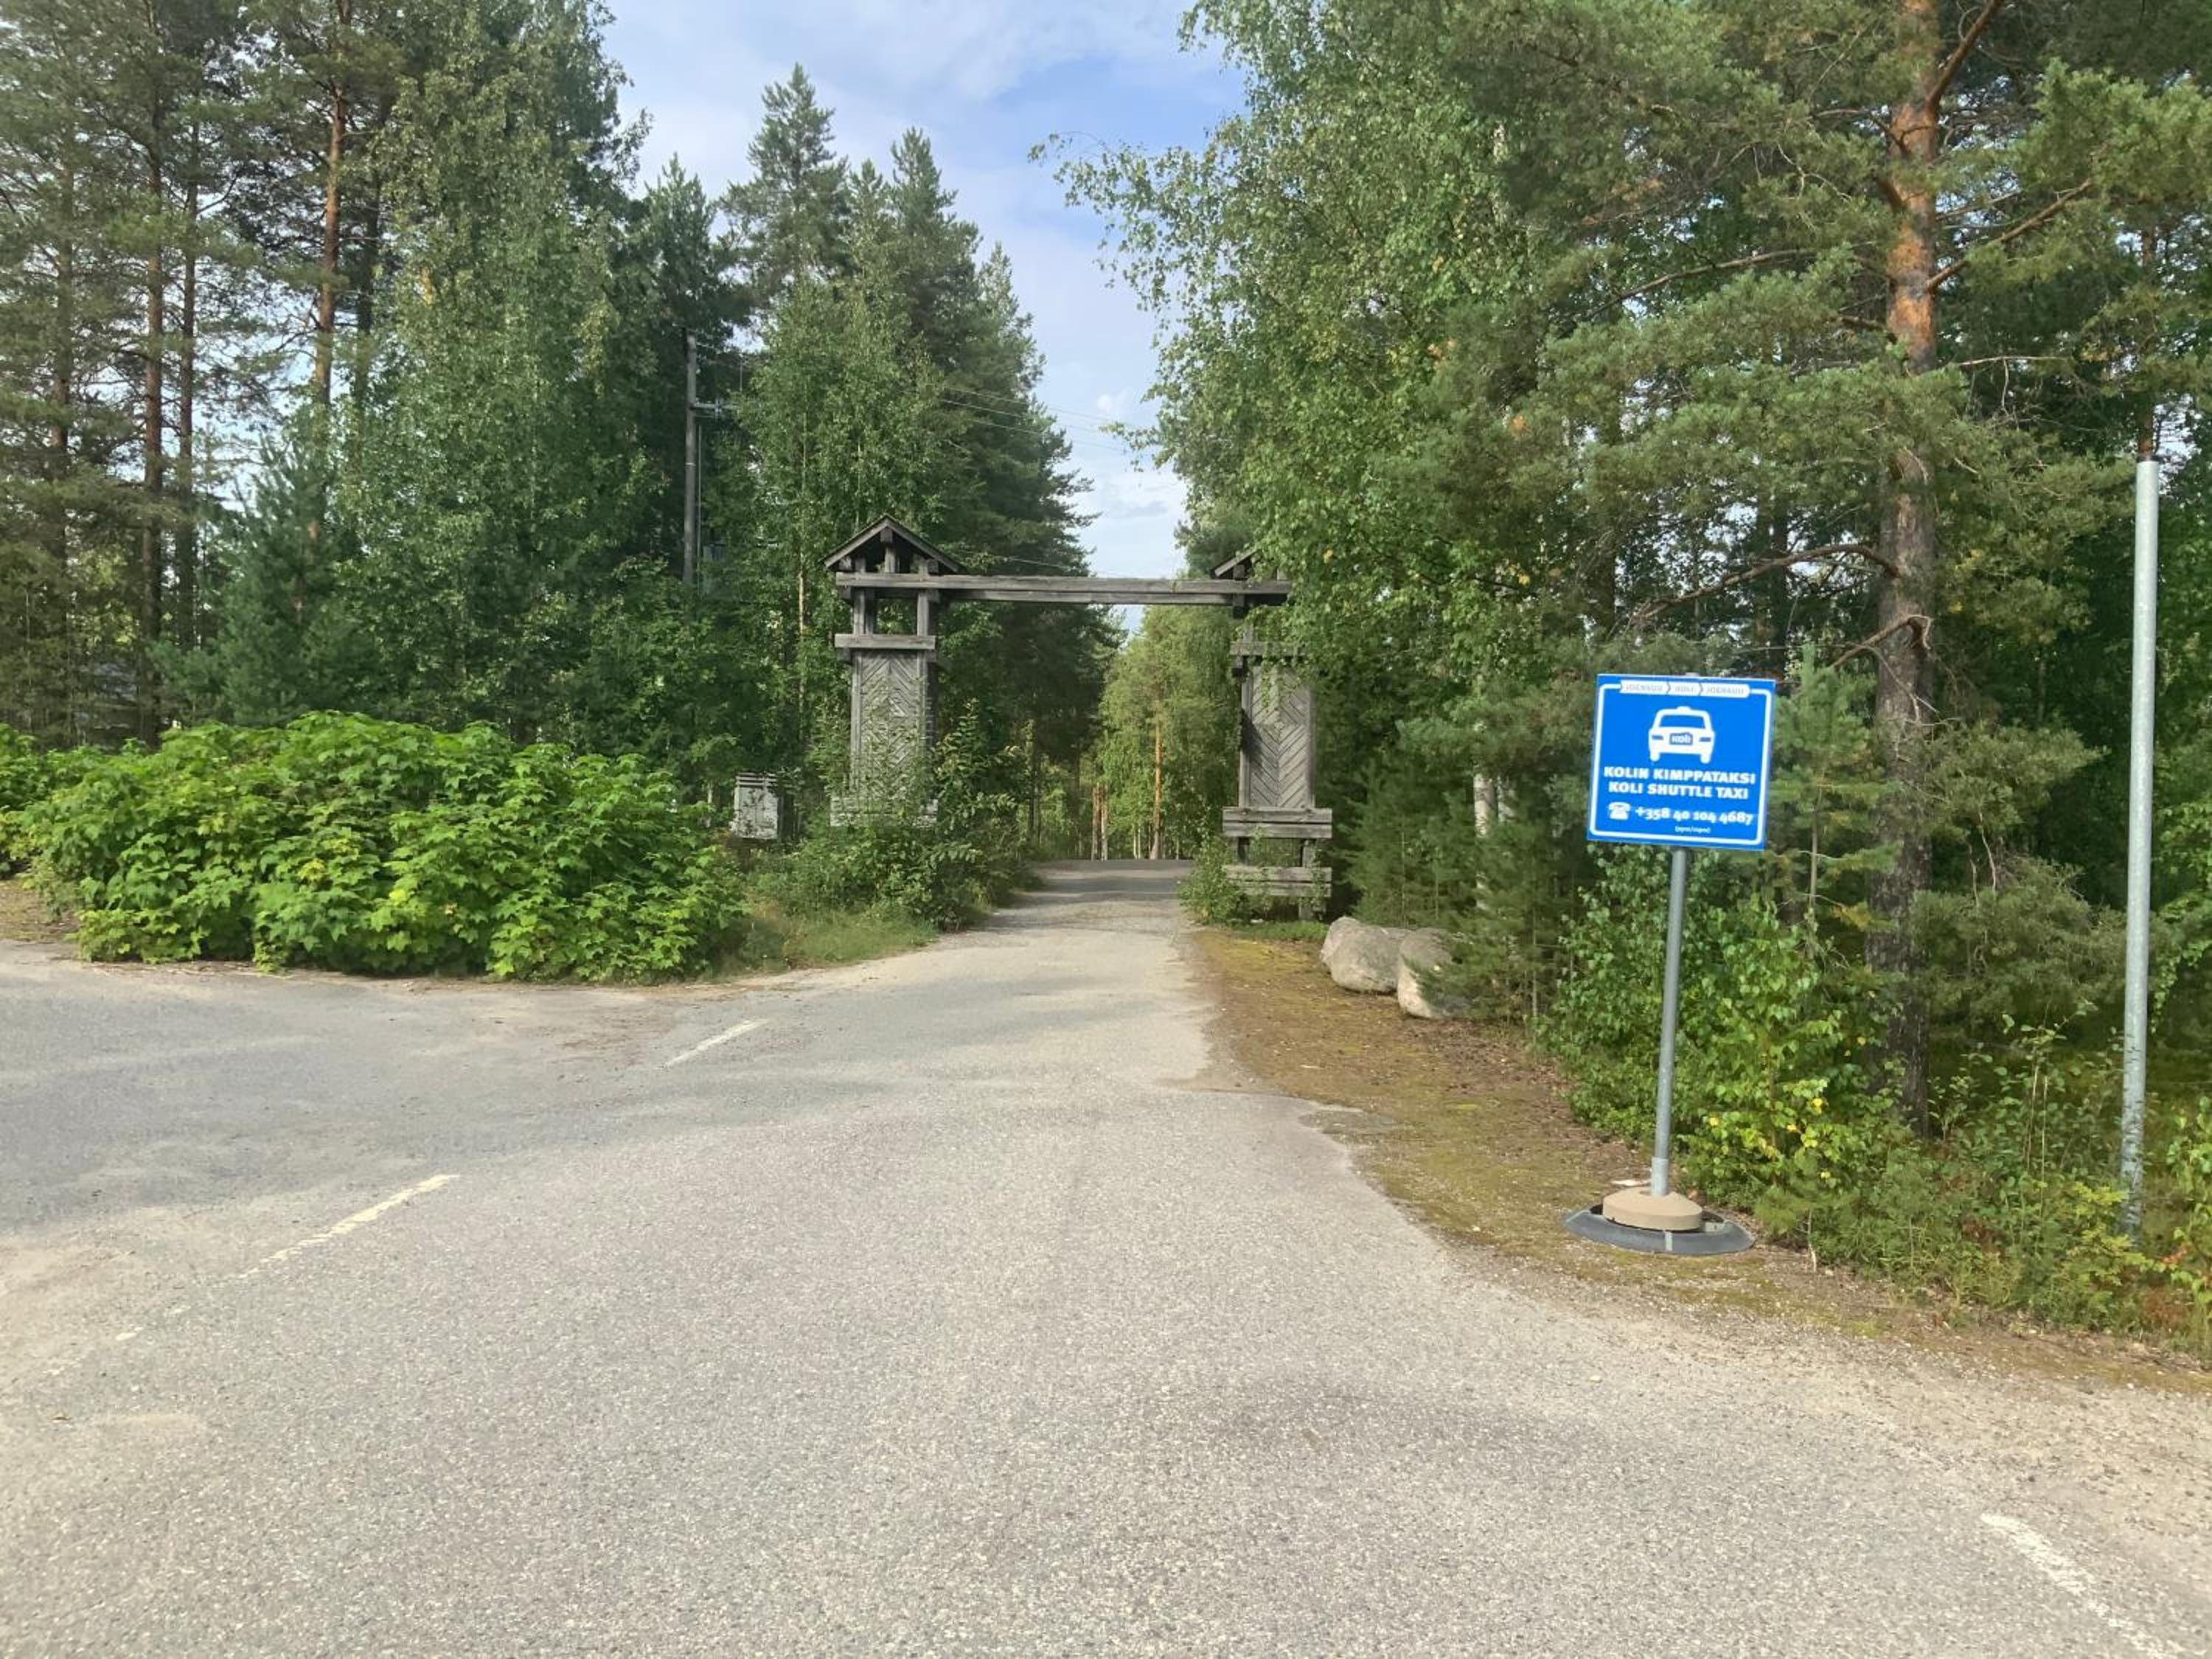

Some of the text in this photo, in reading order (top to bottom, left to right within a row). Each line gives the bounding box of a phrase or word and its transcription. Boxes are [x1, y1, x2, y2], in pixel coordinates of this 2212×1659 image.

[1604, 767, 1756, 784] KOLIN KIMPPATAKSI
[1609, 782, 1748, 799] KOLI SHUTTLE TAXI
[1635, 807, 1753, 825] +358 40 104 4687
